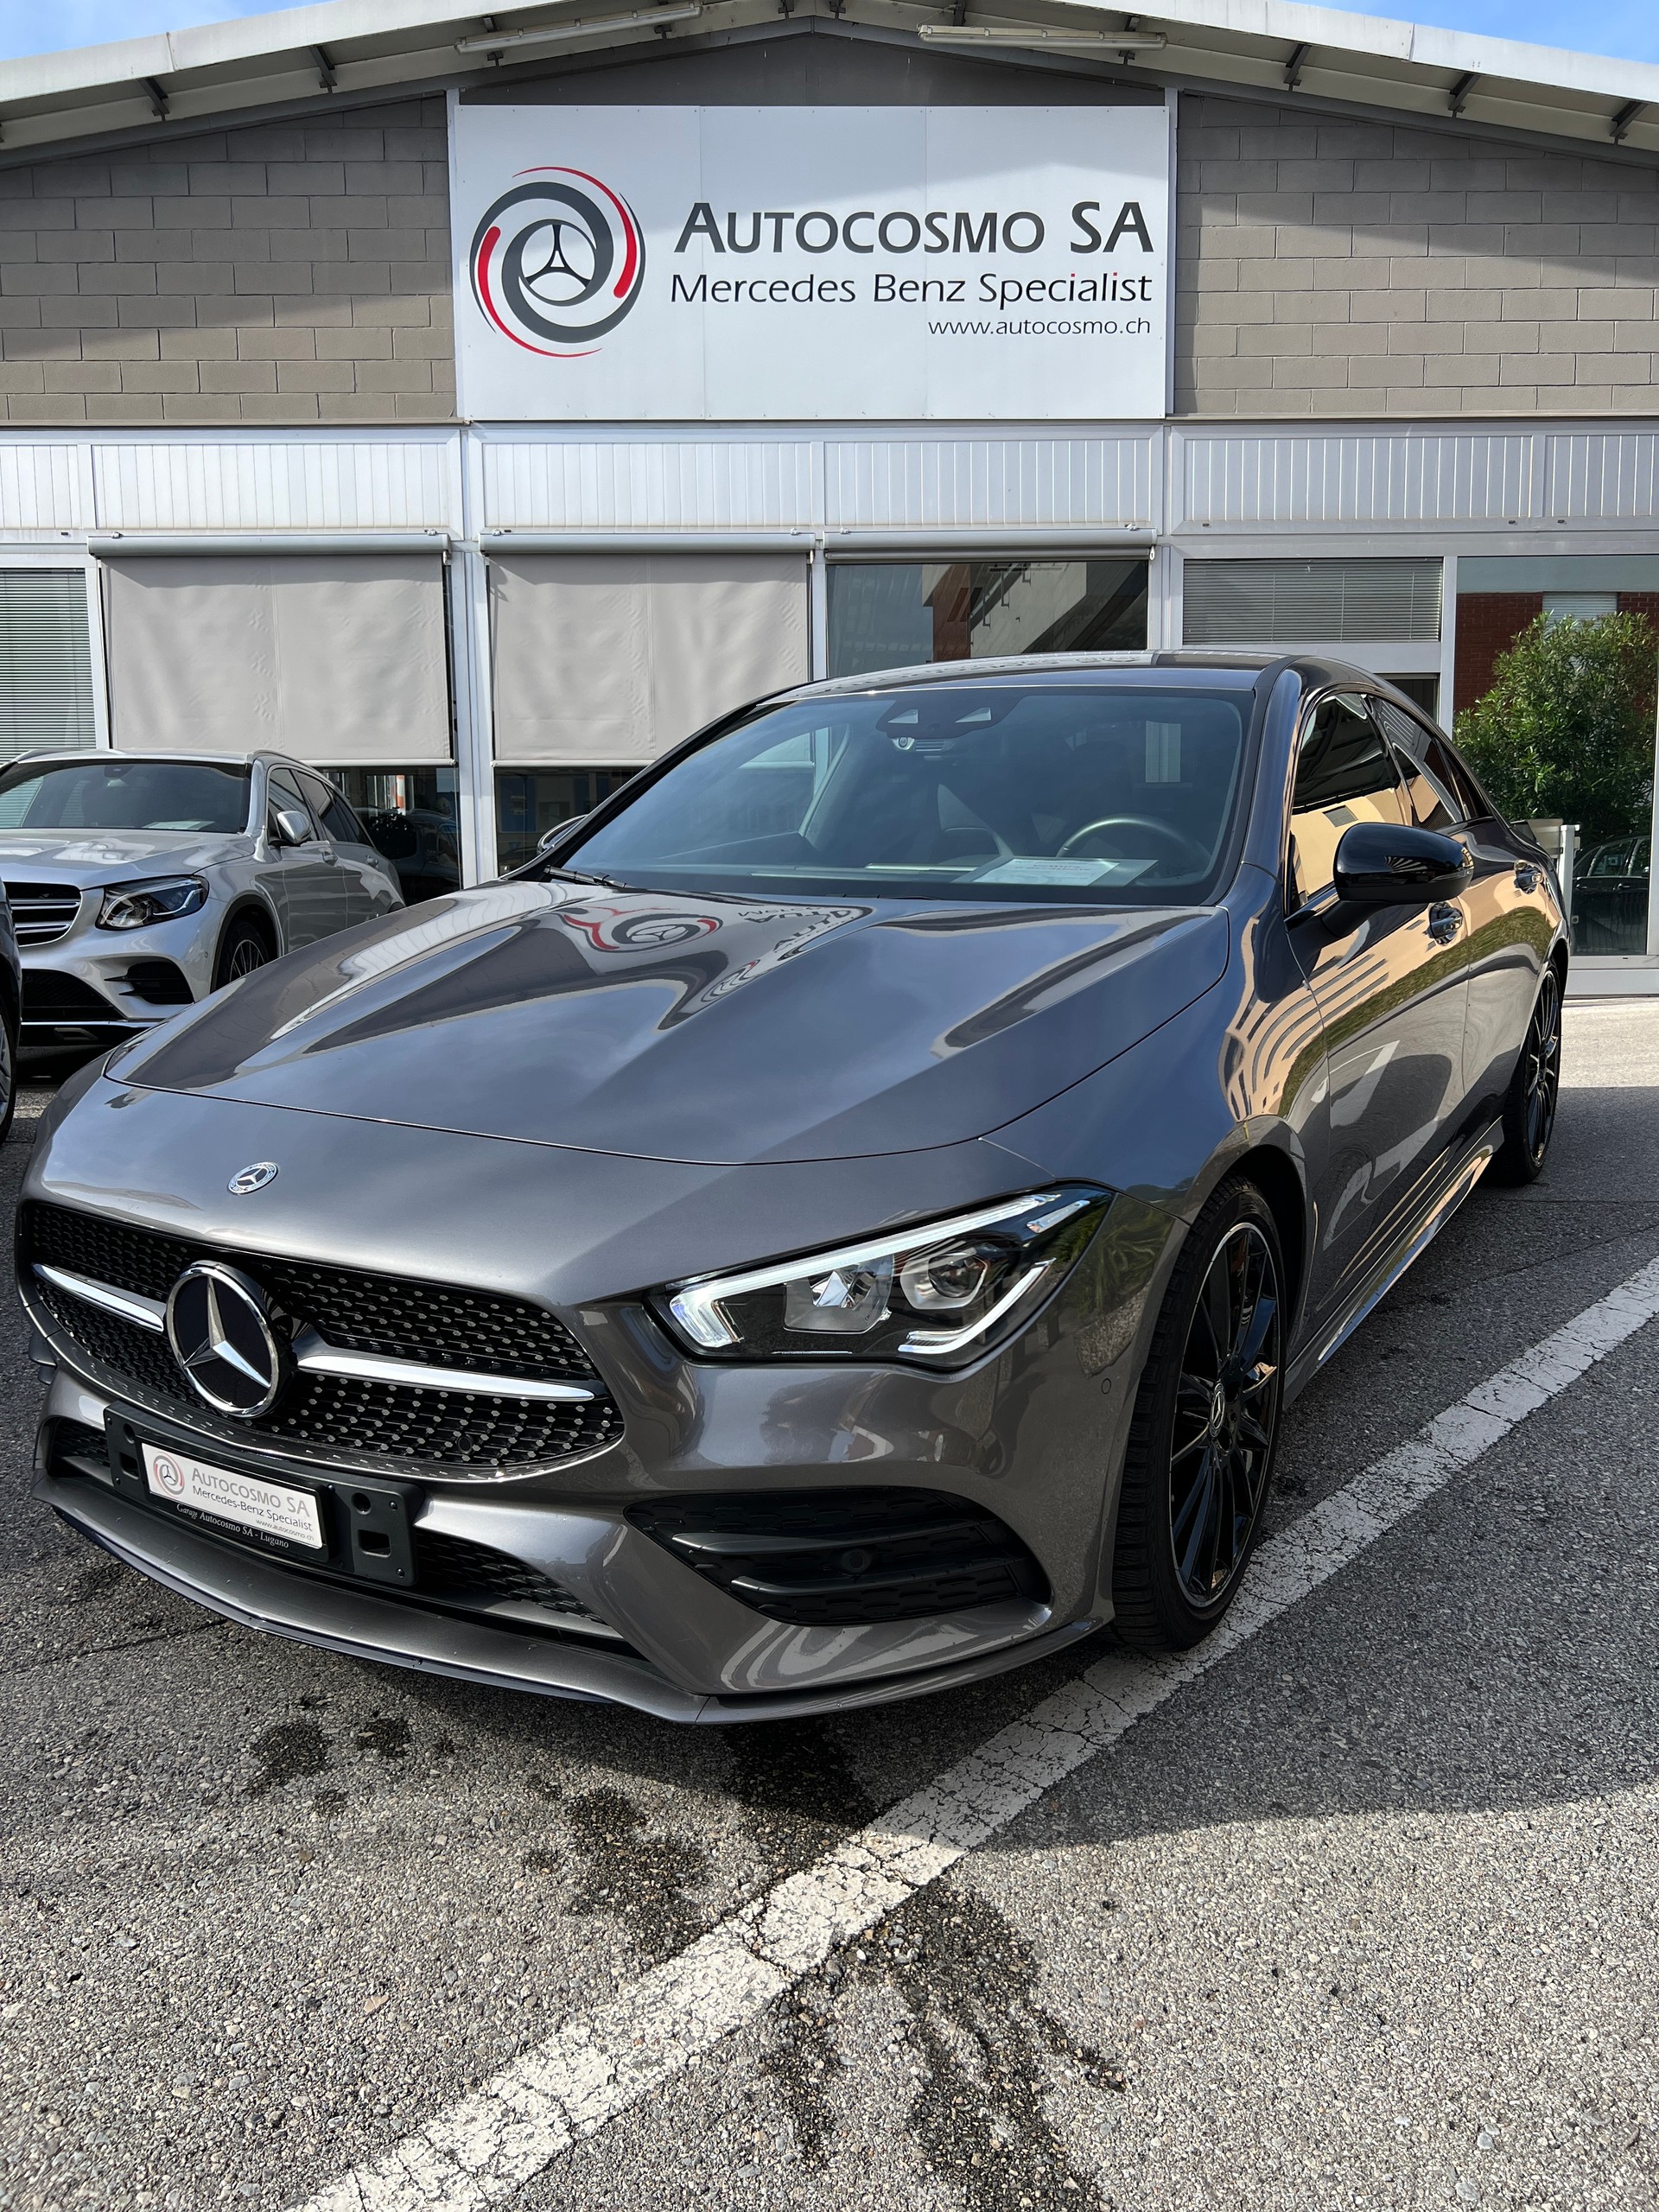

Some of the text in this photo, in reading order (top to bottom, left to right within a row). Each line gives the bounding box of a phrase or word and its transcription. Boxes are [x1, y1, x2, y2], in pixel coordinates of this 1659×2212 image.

[674, 200, 1154, 254] AUTOCOSMO SA
[671, 271, 1154, 311] Mercedes Benz Specialist
[928, 317, 1151, 335] www.autocosmo.ch
[192, 1467, 310, 1518] AUTOCOSMO SA
[193, 1485, 313, 1532] Mercedes-Benz Specialist
[199, 1511, 241, 1533] Autocosmo
[242, 1525, 254, 1537] SA
[259, 1531, 289, 1548] Lugano
